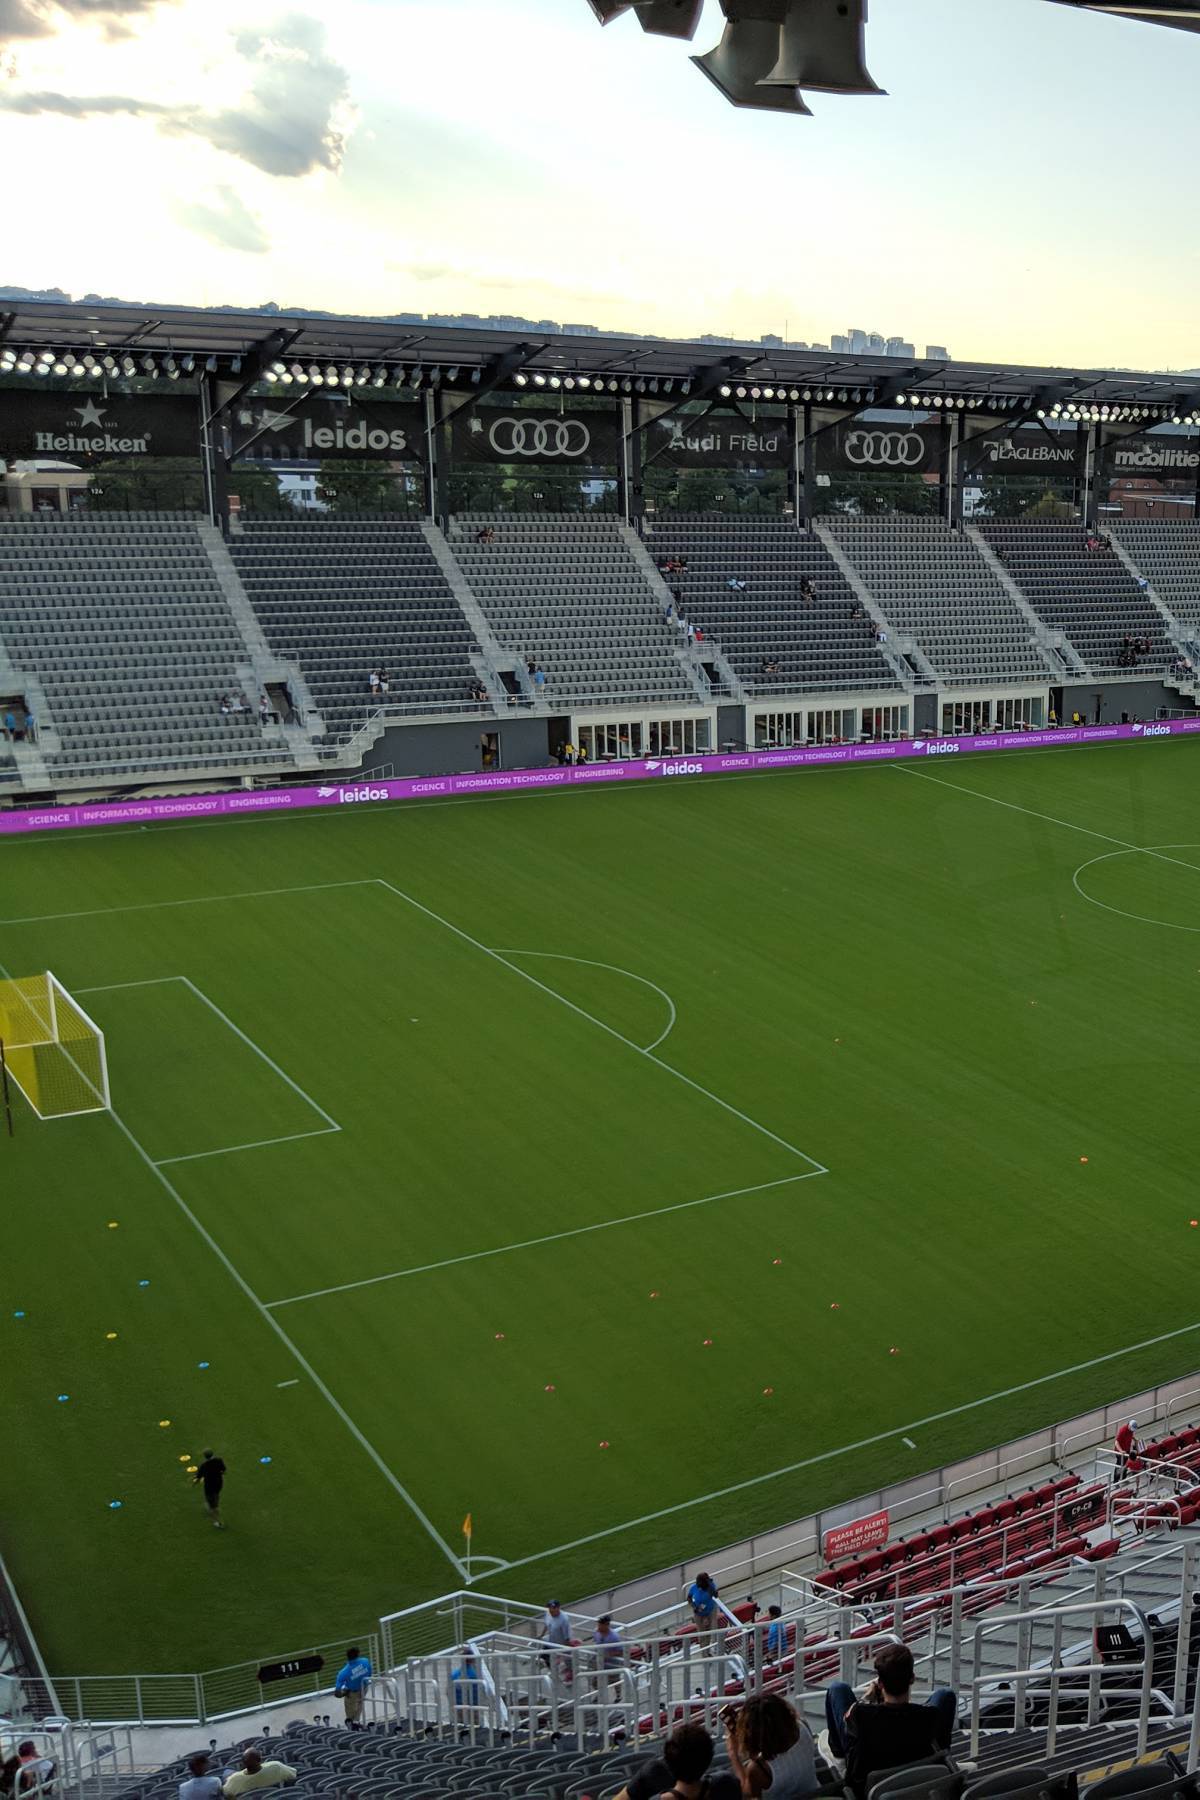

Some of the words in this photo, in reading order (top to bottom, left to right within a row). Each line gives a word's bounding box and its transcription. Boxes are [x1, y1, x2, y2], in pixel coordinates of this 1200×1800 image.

[36, 431, 148, 452] Heineken
[304, 418, 407, 450] leidos
[668, 434, 720, 451] Audi
[728, 434, 777, 452] Field
[1143, 724, 1171, 737] leidos
[926, 742, 959, 754] leidos
[974, 739, 998, 747] SCIENCE
[1004, 736, 1042, 745] INFORMATION
[1042, 733, 1078, 742] TECHNOLOGY
[721, 758, 749, 767] SCIENCE
[757, 754, 804, 764] INFORMATION
[804, 751, 846, 760] TECHNOLOGY
[854, 747, 896, 757] ENGINEERING
[662, 761, 702, 776] leidos
[411, 782, 446, 792] SCIENCE
[456, 777, 512, 789] INFORMATION
[512, 772, 565, 784] TECHNOLOGY
[574, 768, 624, 779] ENGINEERING
[339, 786, 389, 803] leidos
[28, 813, 70, 825] SCIENCE
[83, 807, 152, 820] INFORMATION
[153, 801, 217, 814] TECHNOLOGY
[229, 795, 291, 808] ENGINEERING
[830, 1530, 854, 1543] PLEASE
[855, 1526, 863, 1534] BE
[864, 1517, 887, 1530] ALERT!
[835, 1540, 850, 1549] BALL
[864, 1528, 883, 1539] LEAVE
[844, 1541, 861, 1551] FIELD
[861, 1591, 878, 1605] C9
[1109, 1633, 1122, 1646] 111
[280, 1661, 300, 1673] 111
